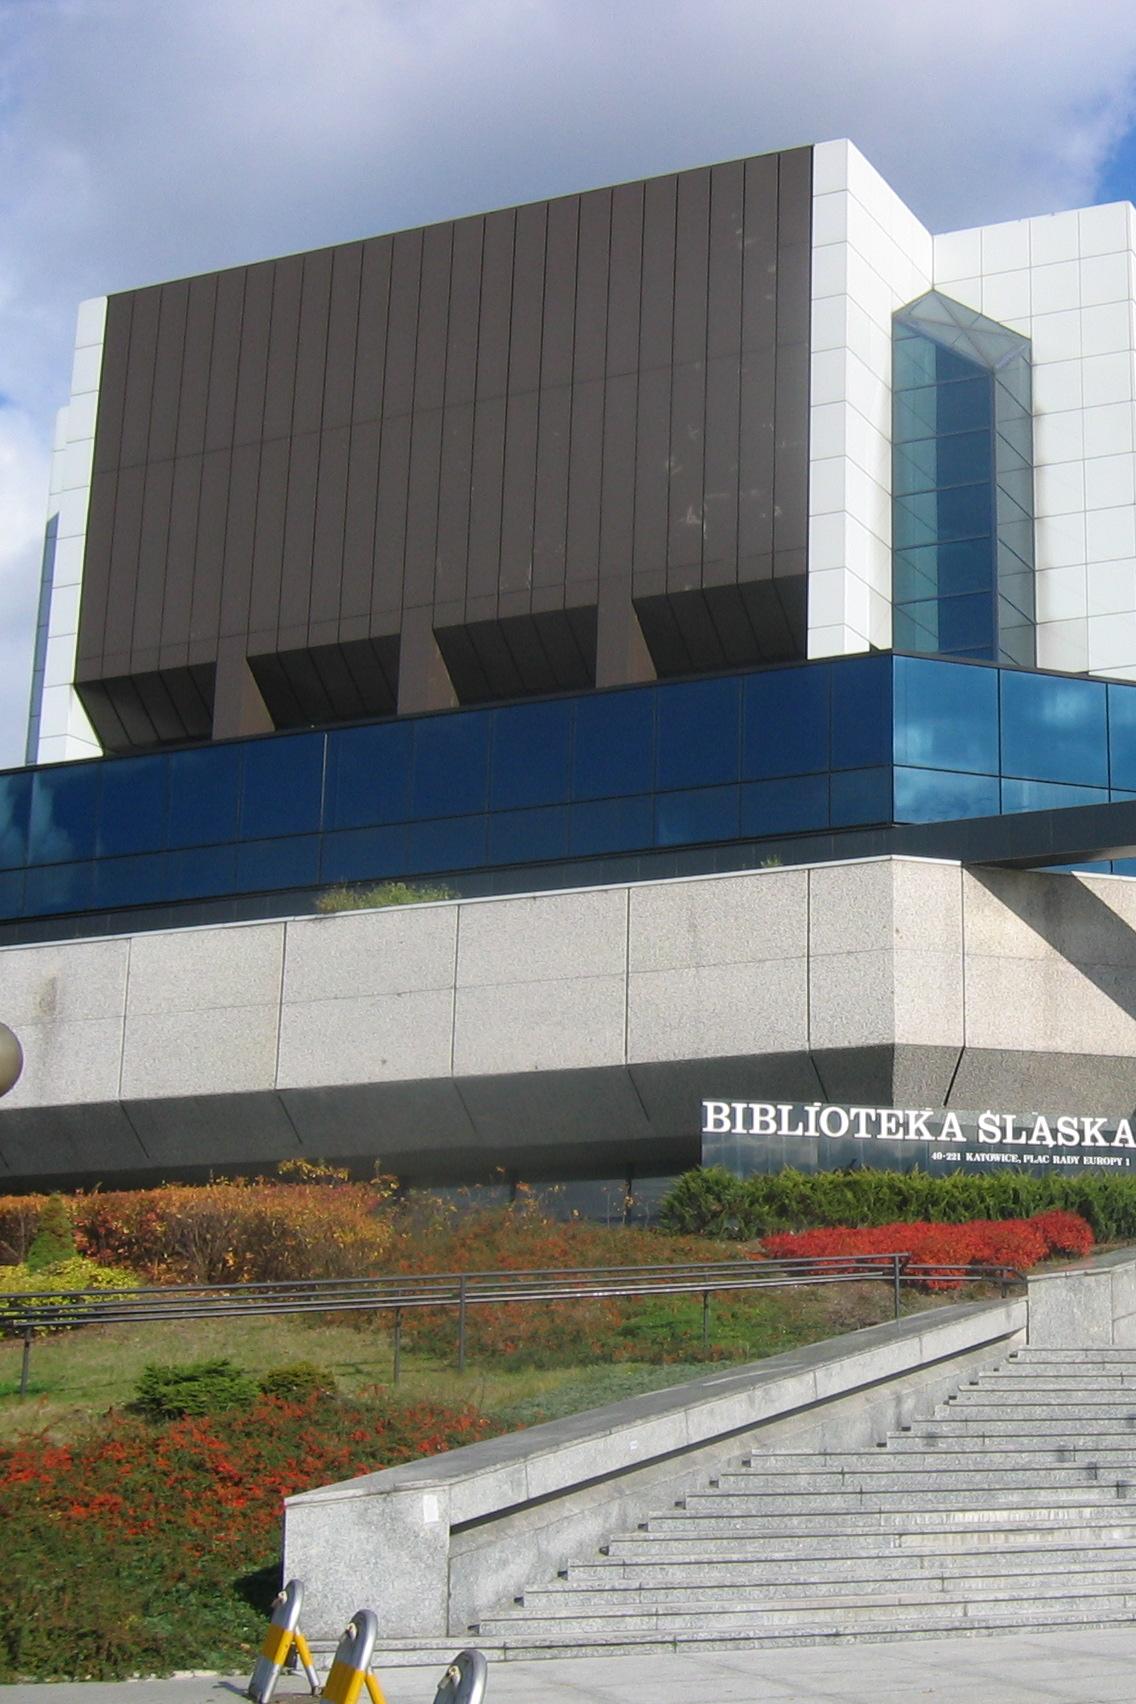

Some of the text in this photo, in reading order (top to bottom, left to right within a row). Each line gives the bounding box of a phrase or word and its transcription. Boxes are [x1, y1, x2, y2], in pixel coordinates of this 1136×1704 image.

[1023, 1154, 1050, 1164] PLAC
[1052, 1154, 1080, 1165] RADY
[1083, 1156, 1123, 1166] EUROPY
[1125, 1157, 1131, 1167] 1
